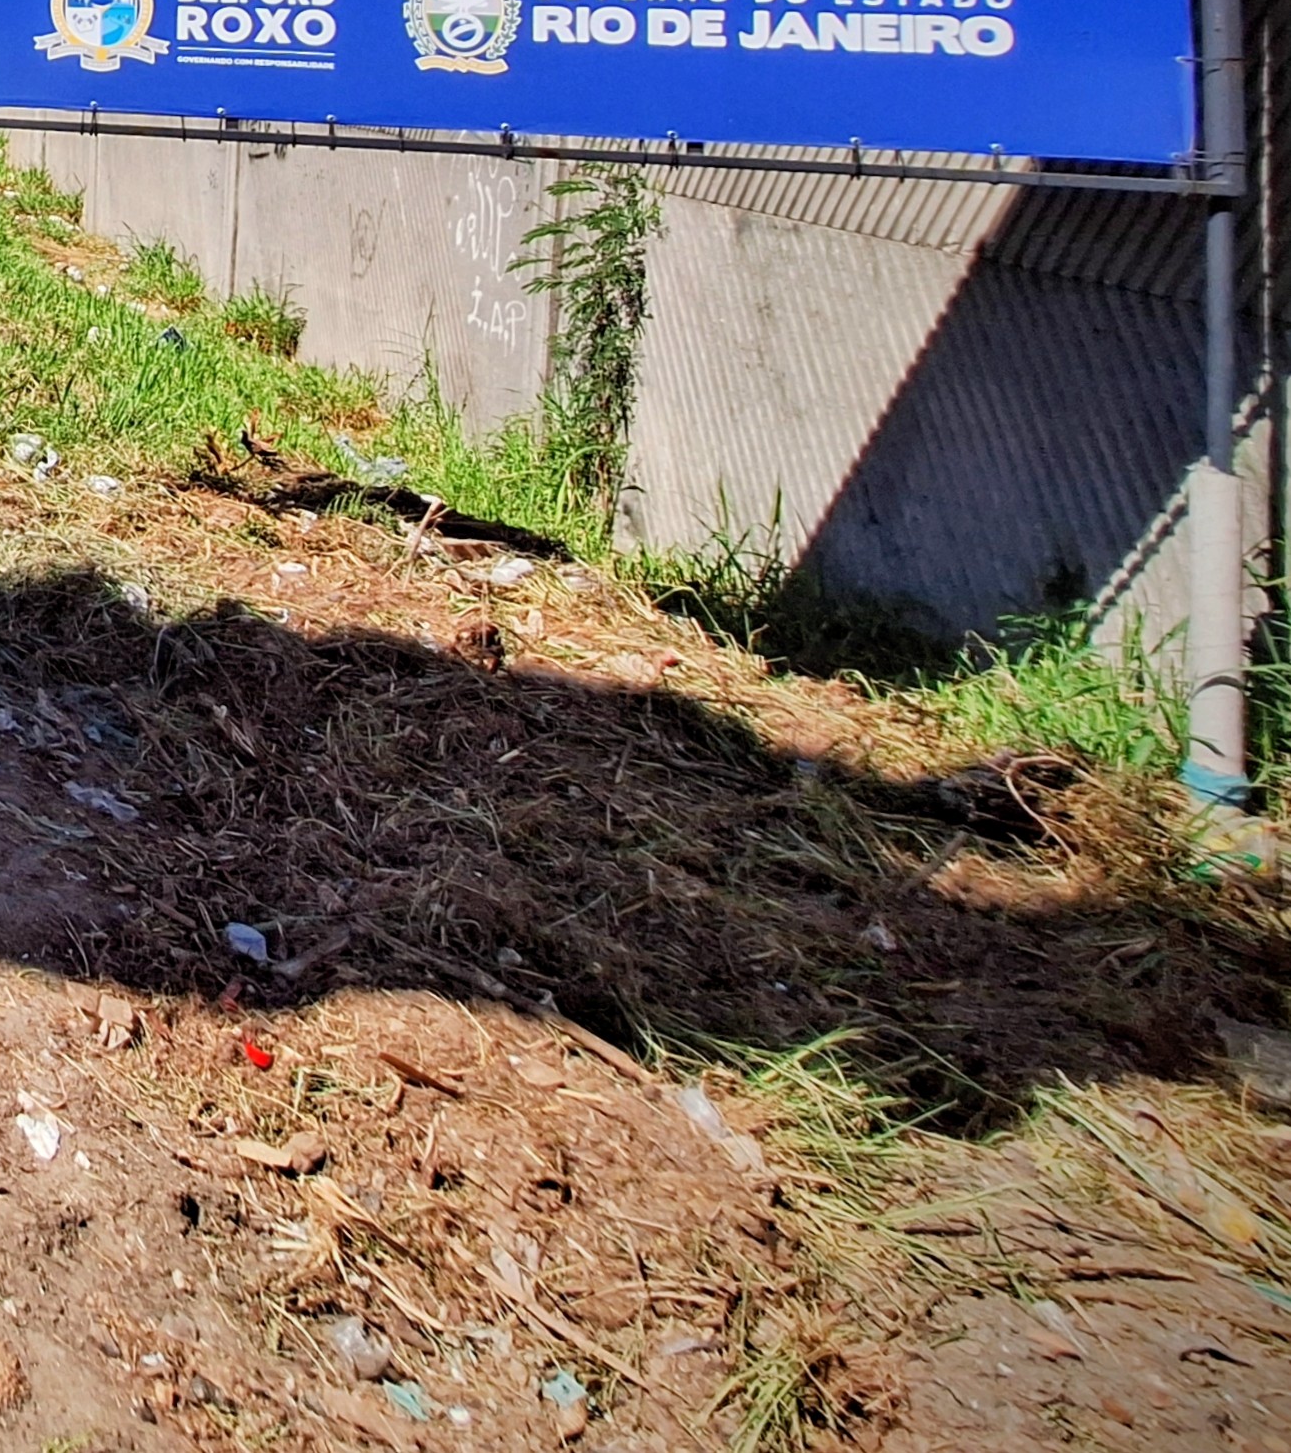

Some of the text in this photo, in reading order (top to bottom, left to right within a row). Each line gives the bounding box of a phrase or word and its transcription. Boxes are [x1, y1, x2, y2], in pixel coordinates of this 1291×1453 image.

[176, 5, 337, 47] ROXO
[532, 5, 1015, 57] RIO DE JANEIRO
[177, 55, 336, 70] GOVERNANDO COM RESPONSABILIDADE
